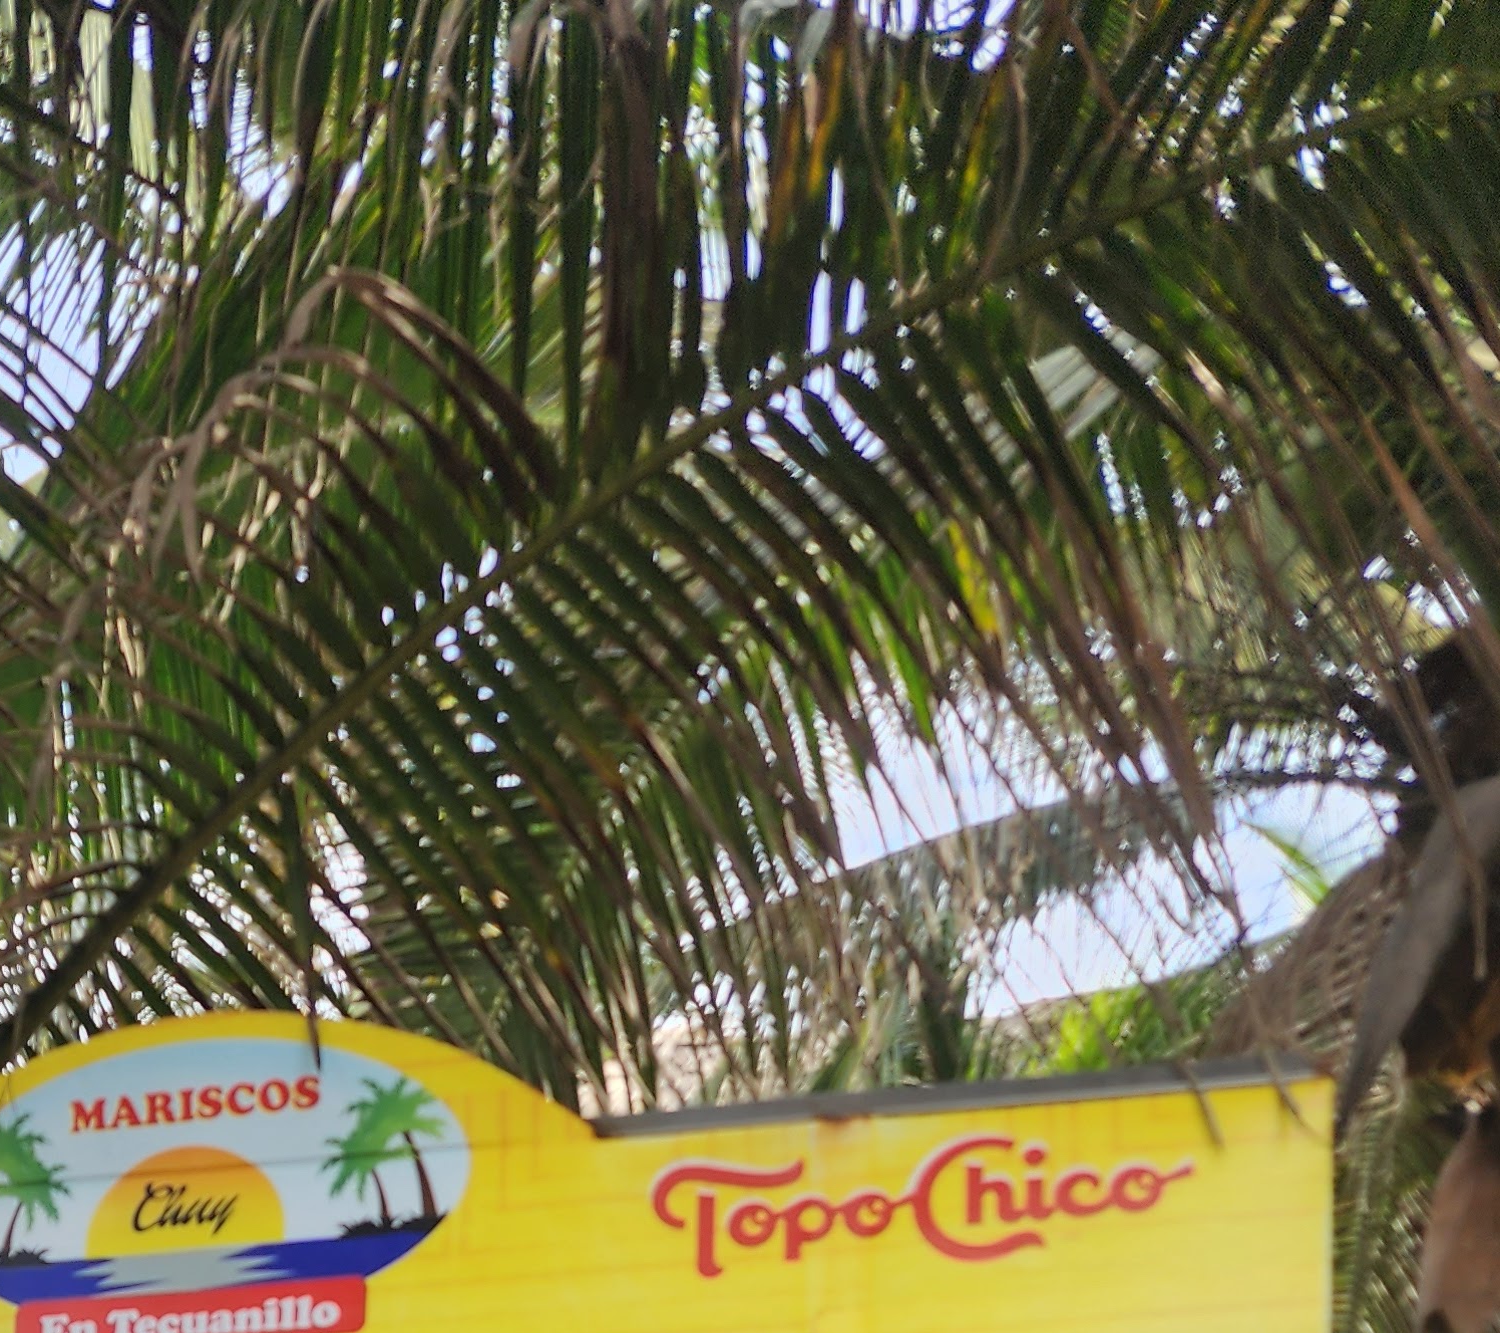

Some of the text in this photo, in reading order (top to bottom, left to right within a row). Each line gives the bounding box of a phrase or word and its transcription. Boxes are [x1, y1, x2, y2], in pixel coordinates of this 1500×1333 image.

[70, 1076, 320, 1132] MARISCOS
[652, 1134, 1194, 1279] Topo Chico
